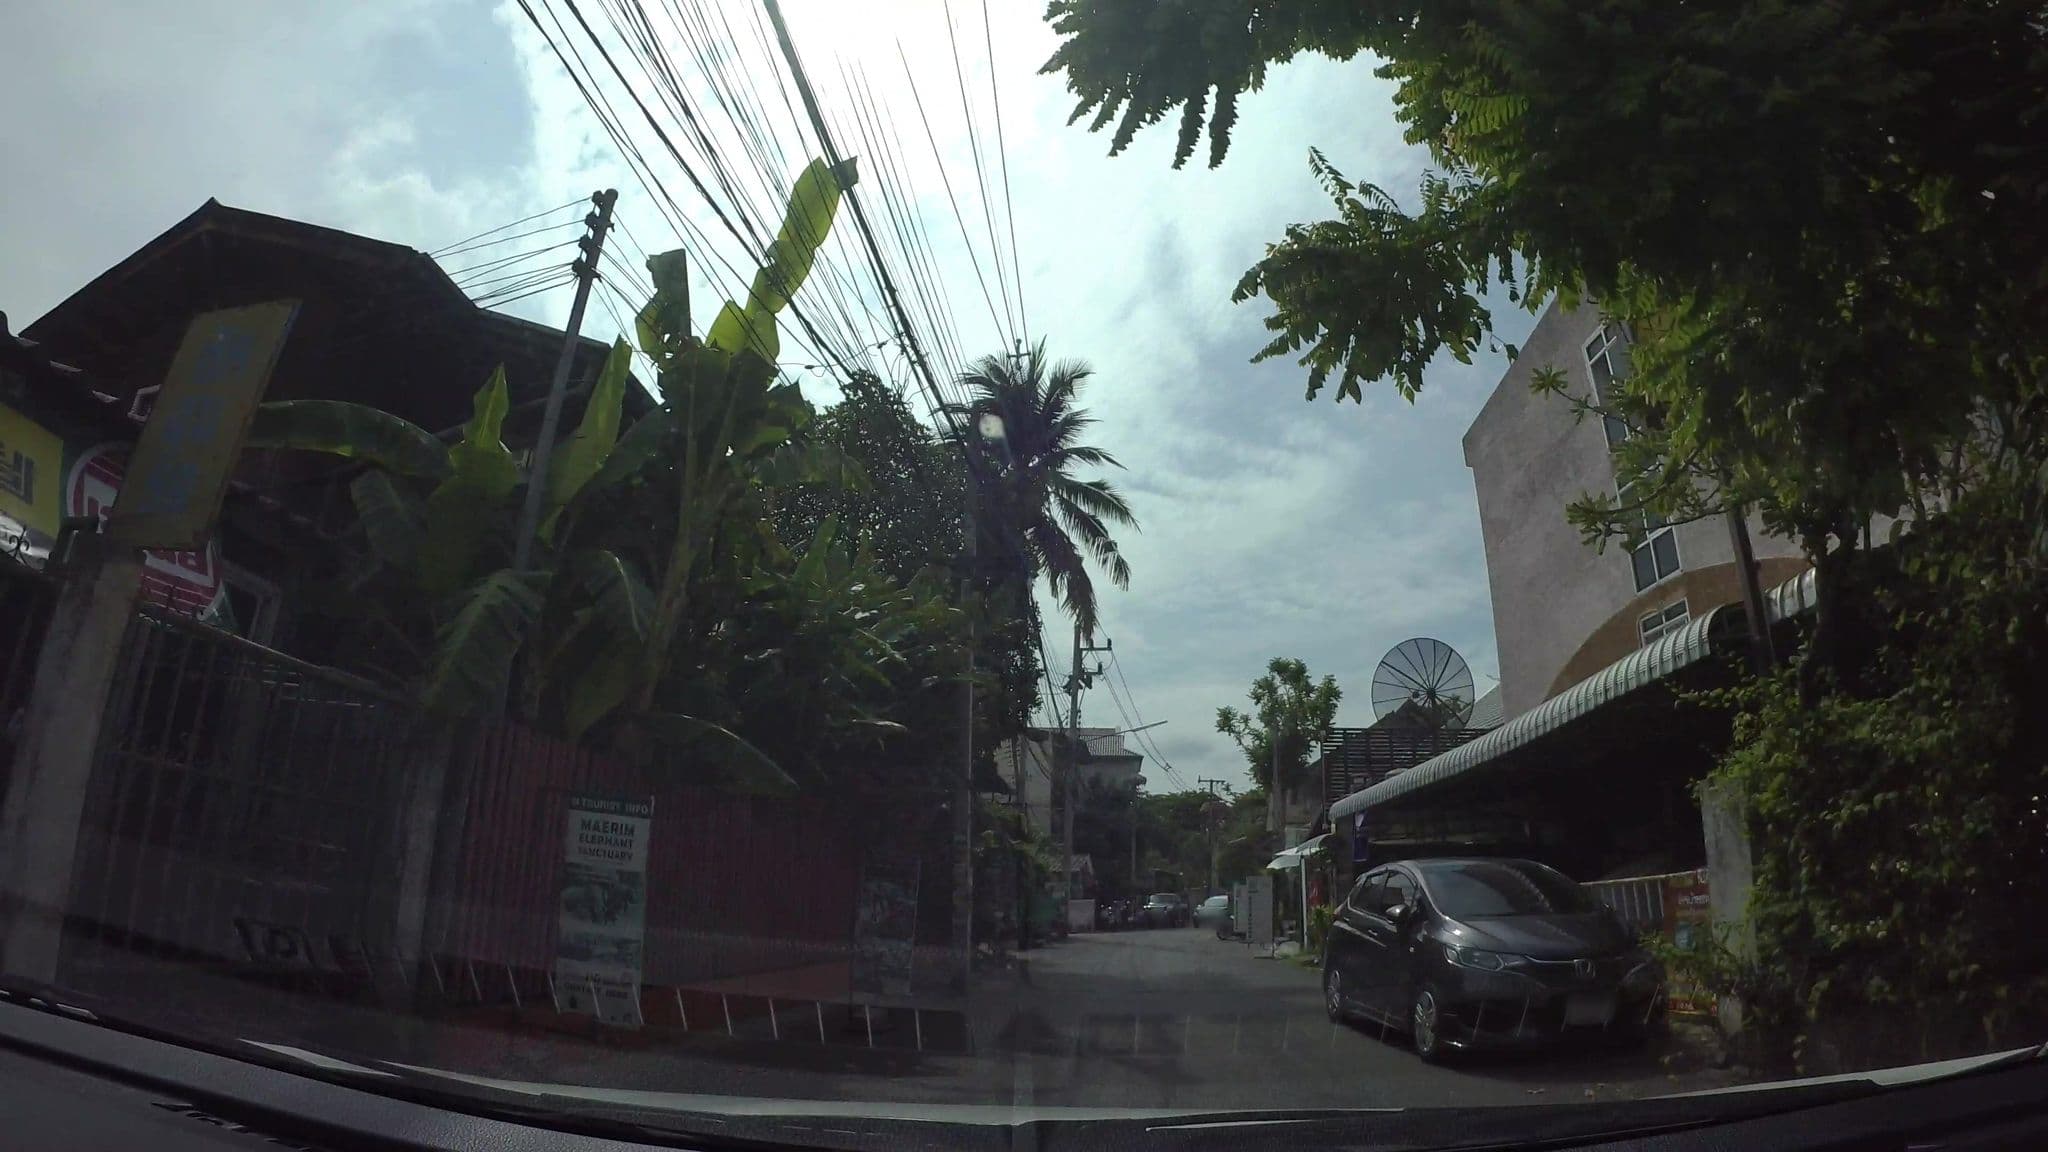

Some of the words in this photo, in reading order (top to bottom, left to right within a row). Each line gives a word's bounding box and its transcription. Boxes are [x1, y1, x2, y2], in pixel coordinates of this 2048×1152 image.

[625, 803, 649, 815] INFO
[581, 818, 635, 837] MAERIM
[578, 832, 633, 849] ELEPHANT
[577, 846, 633, 861] SANCTUARY
